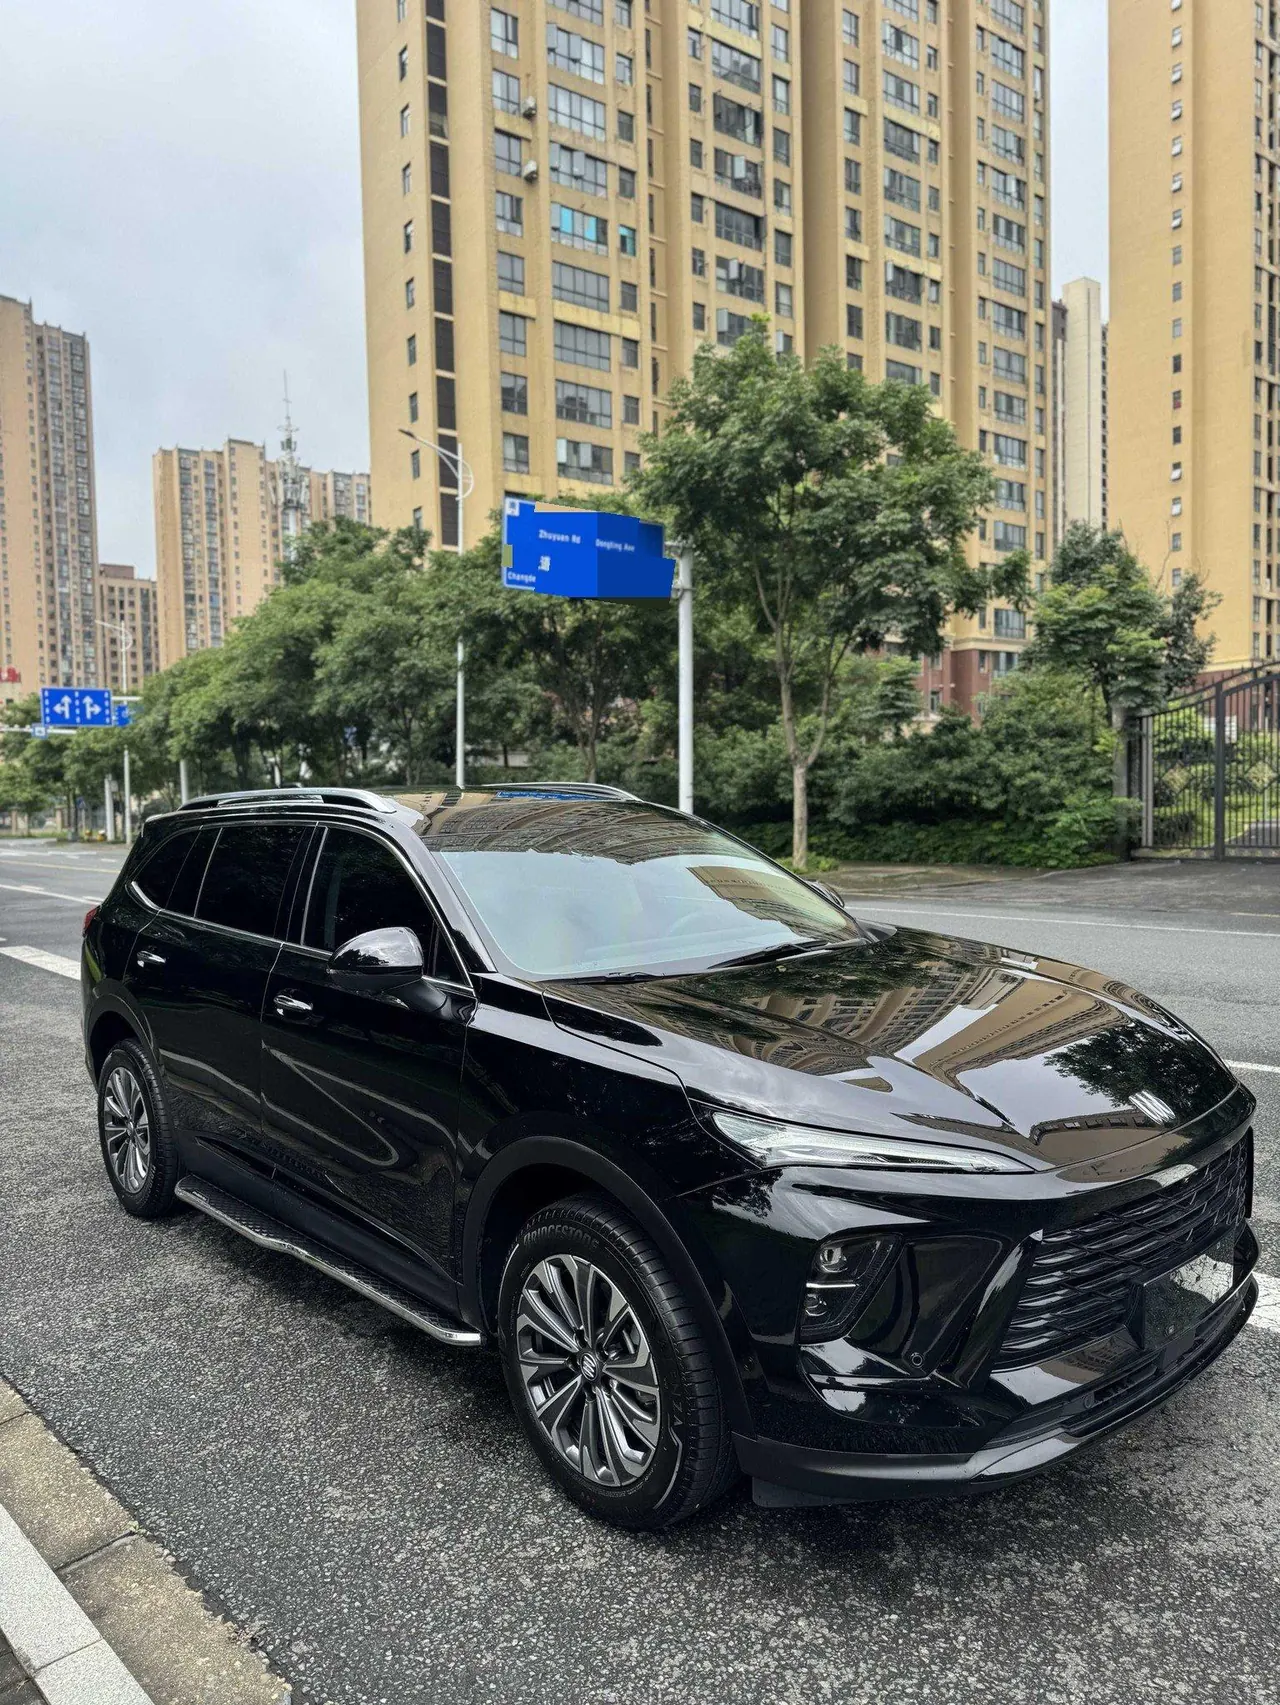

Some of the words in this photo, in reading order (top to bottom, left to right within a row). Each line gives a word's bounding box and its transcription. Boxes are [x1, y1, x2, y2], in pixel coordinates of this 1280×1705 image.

[539, 530, 569, 542] Zhuyuan
[571, 533, 581, 544] Rd
[508, 571, 536, 583] Changde
[523, 1224, 601, 1251] BRIDGESTONE
